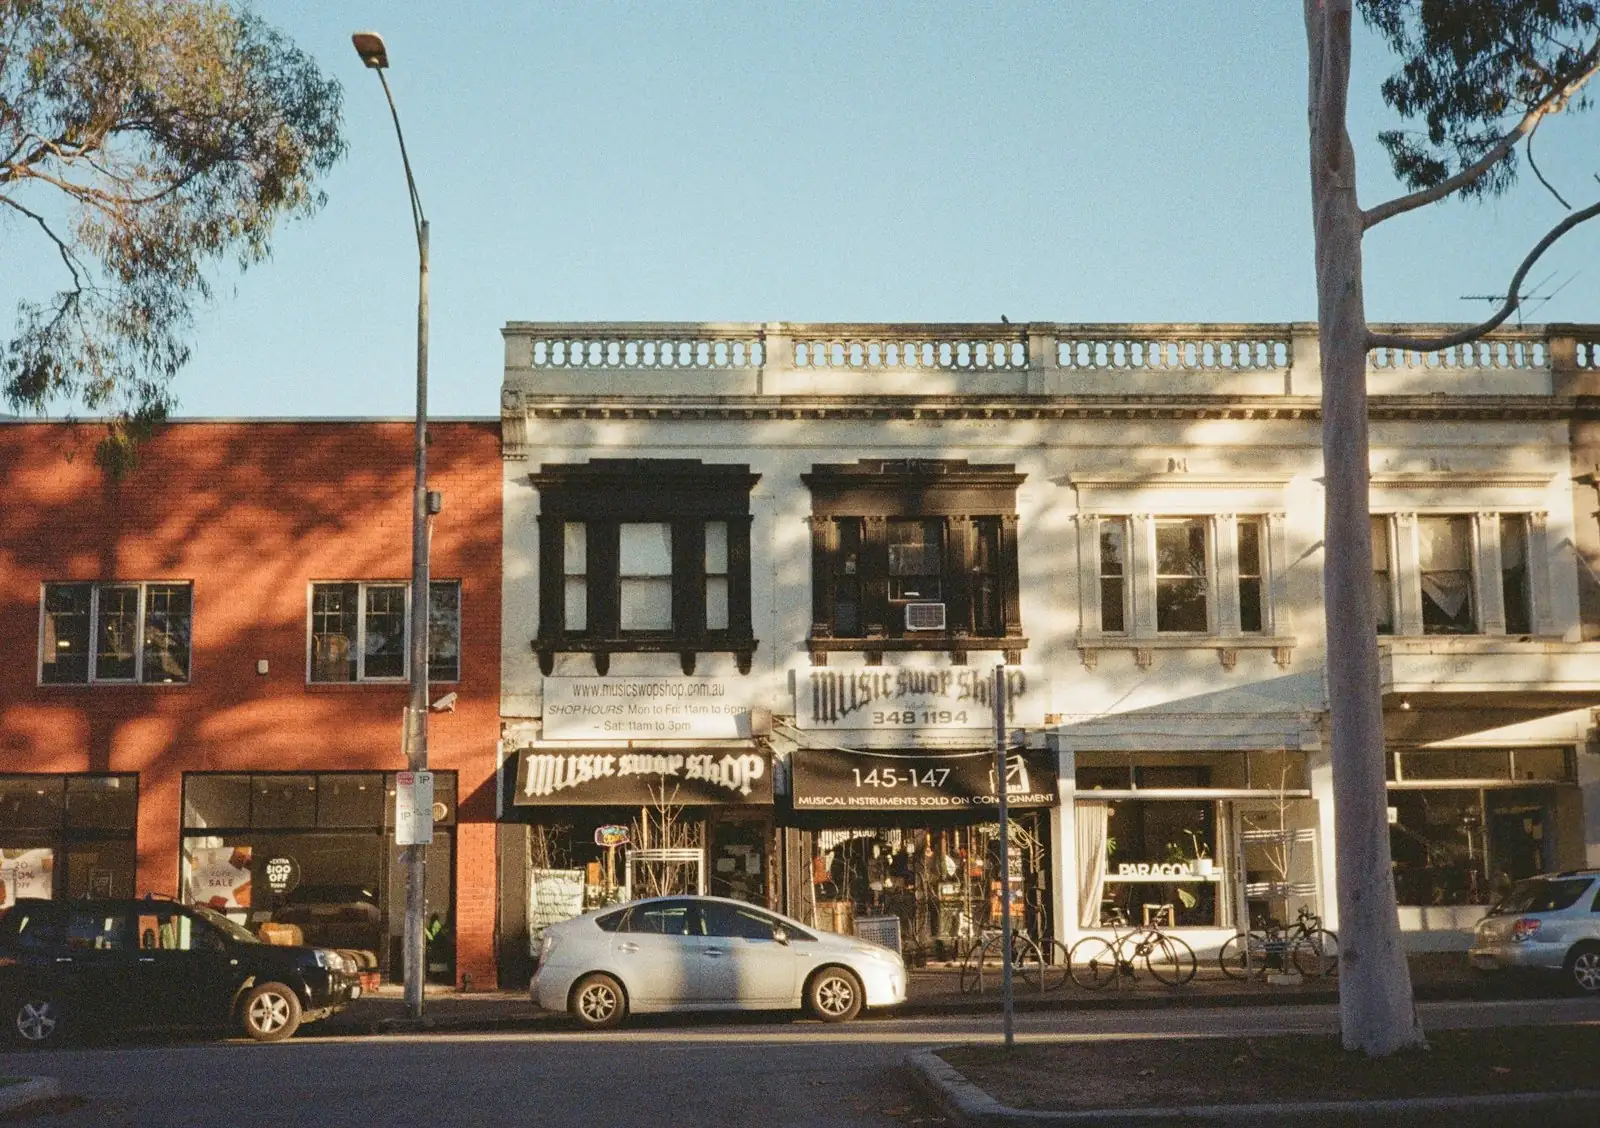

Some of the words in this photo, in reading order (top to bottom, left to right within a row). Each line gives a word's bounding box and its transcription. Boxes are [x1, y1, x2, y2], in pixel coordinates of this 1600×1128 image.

[572, 680, 725, 700] www.musicswopshop.com.au
[548, 704, 581, 715] SHOP
[583, 704, 624, 715] HOURS
[628, 705, 651, 715] Mon
[653, 705, 663, 715] to
[684, 704, 709, 715] 11am
[711, 705, 721, 714] to
[723, 704, 747, 716] 6pm
[872, 711, 916, 725] 348
[921, 710, 969, 724] 1194
[628, 721, 653, 731] 11am
[655, 721, 665, 731] to
[668, 721, 691, 733] 3pm
[852, 768, 951, 788] 145-147
[798, 796, 846, 806] MUSICAL
[848, 796, 917, 806] INSTRUMENTS
[920, 796, 949, 806] SOLD
[951, 795, 970, 805] ON
[972, 793, 1054, 805] CONGNMENT
[266, 865, 291, 874] $100
[1119, 863, 1194, 876] PARAGON
[208, 879, 234, 887] SALE
[269, 873, 288, 883] OFF
